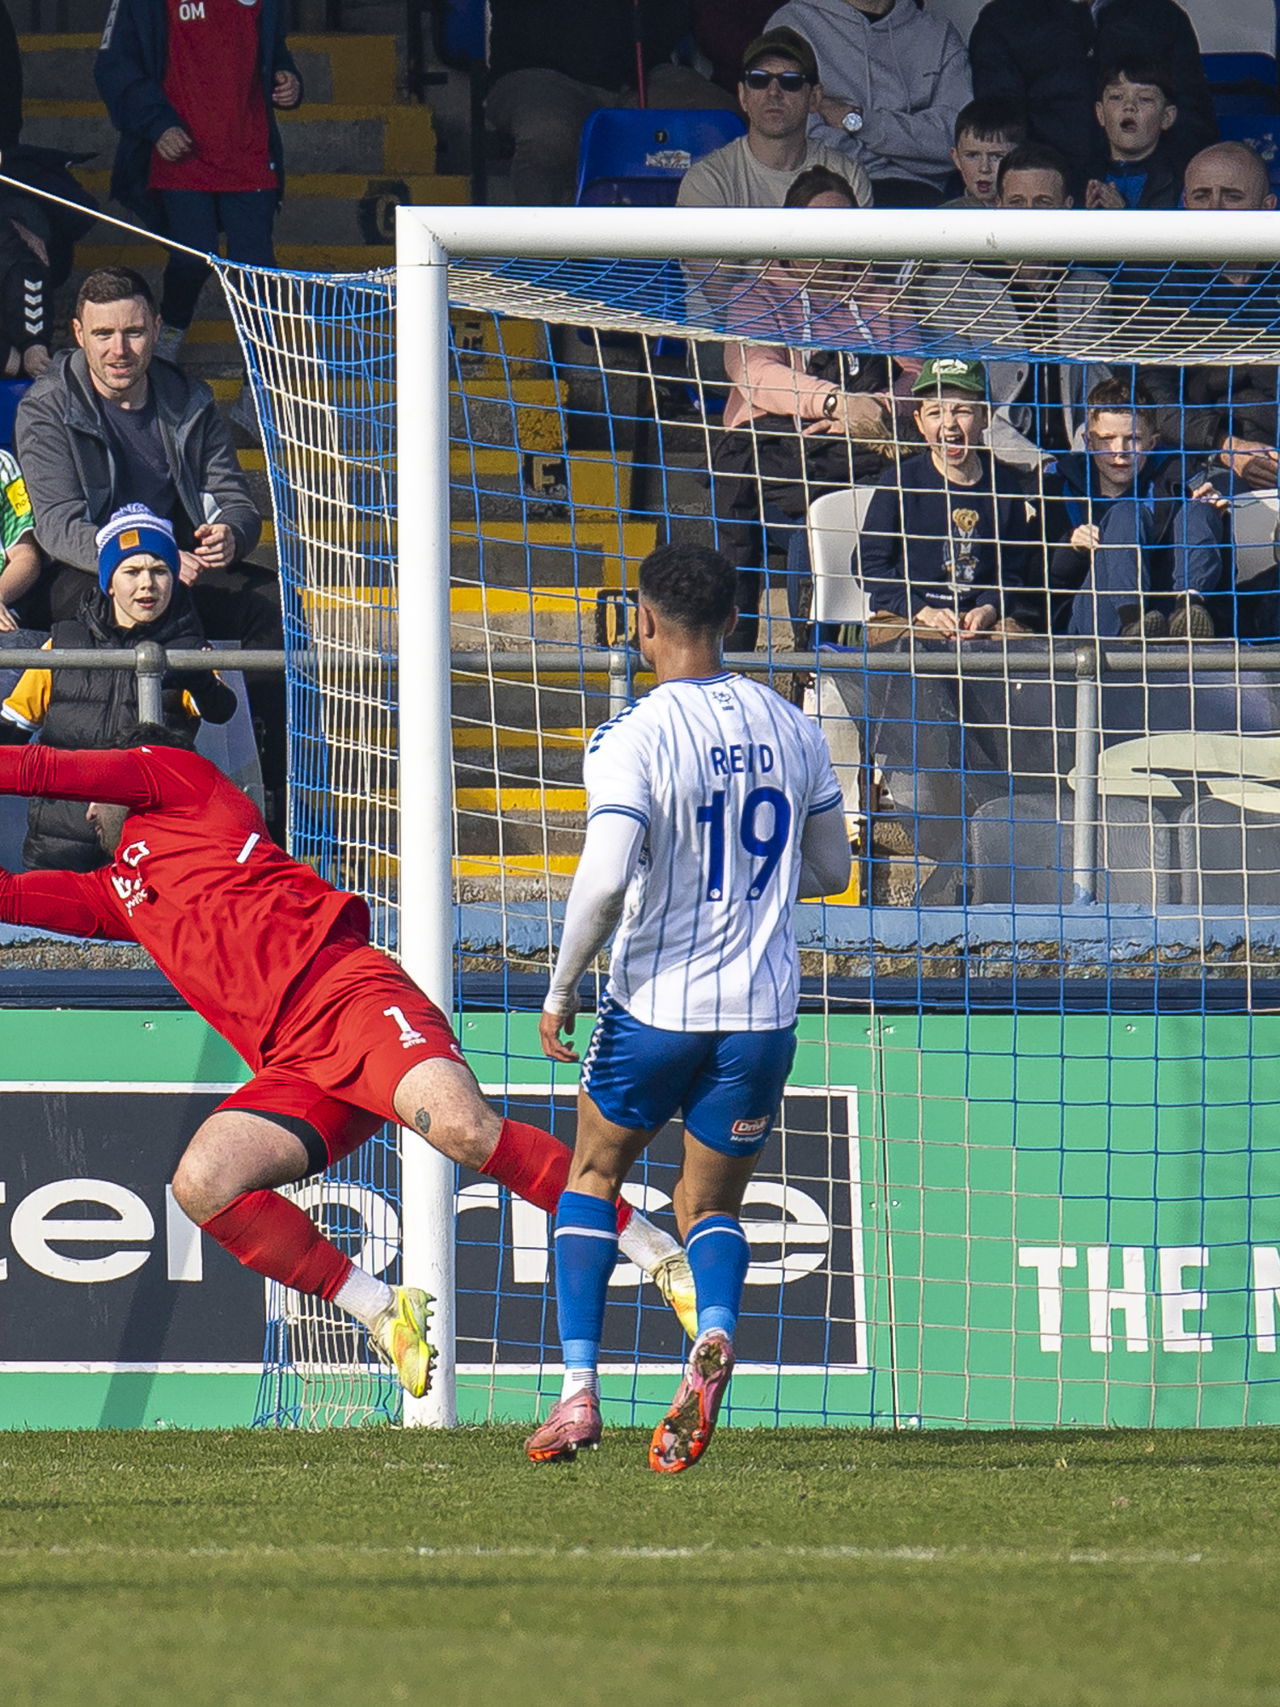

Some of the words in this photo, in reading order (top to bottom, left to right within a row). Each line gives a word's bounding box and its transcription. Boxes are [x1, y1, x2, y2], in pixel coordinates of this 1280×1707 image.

[710, 743, 775, 776] REID
[696, 785, 792, 902] 19
[1018, 1246, 1214, 1353] THE
